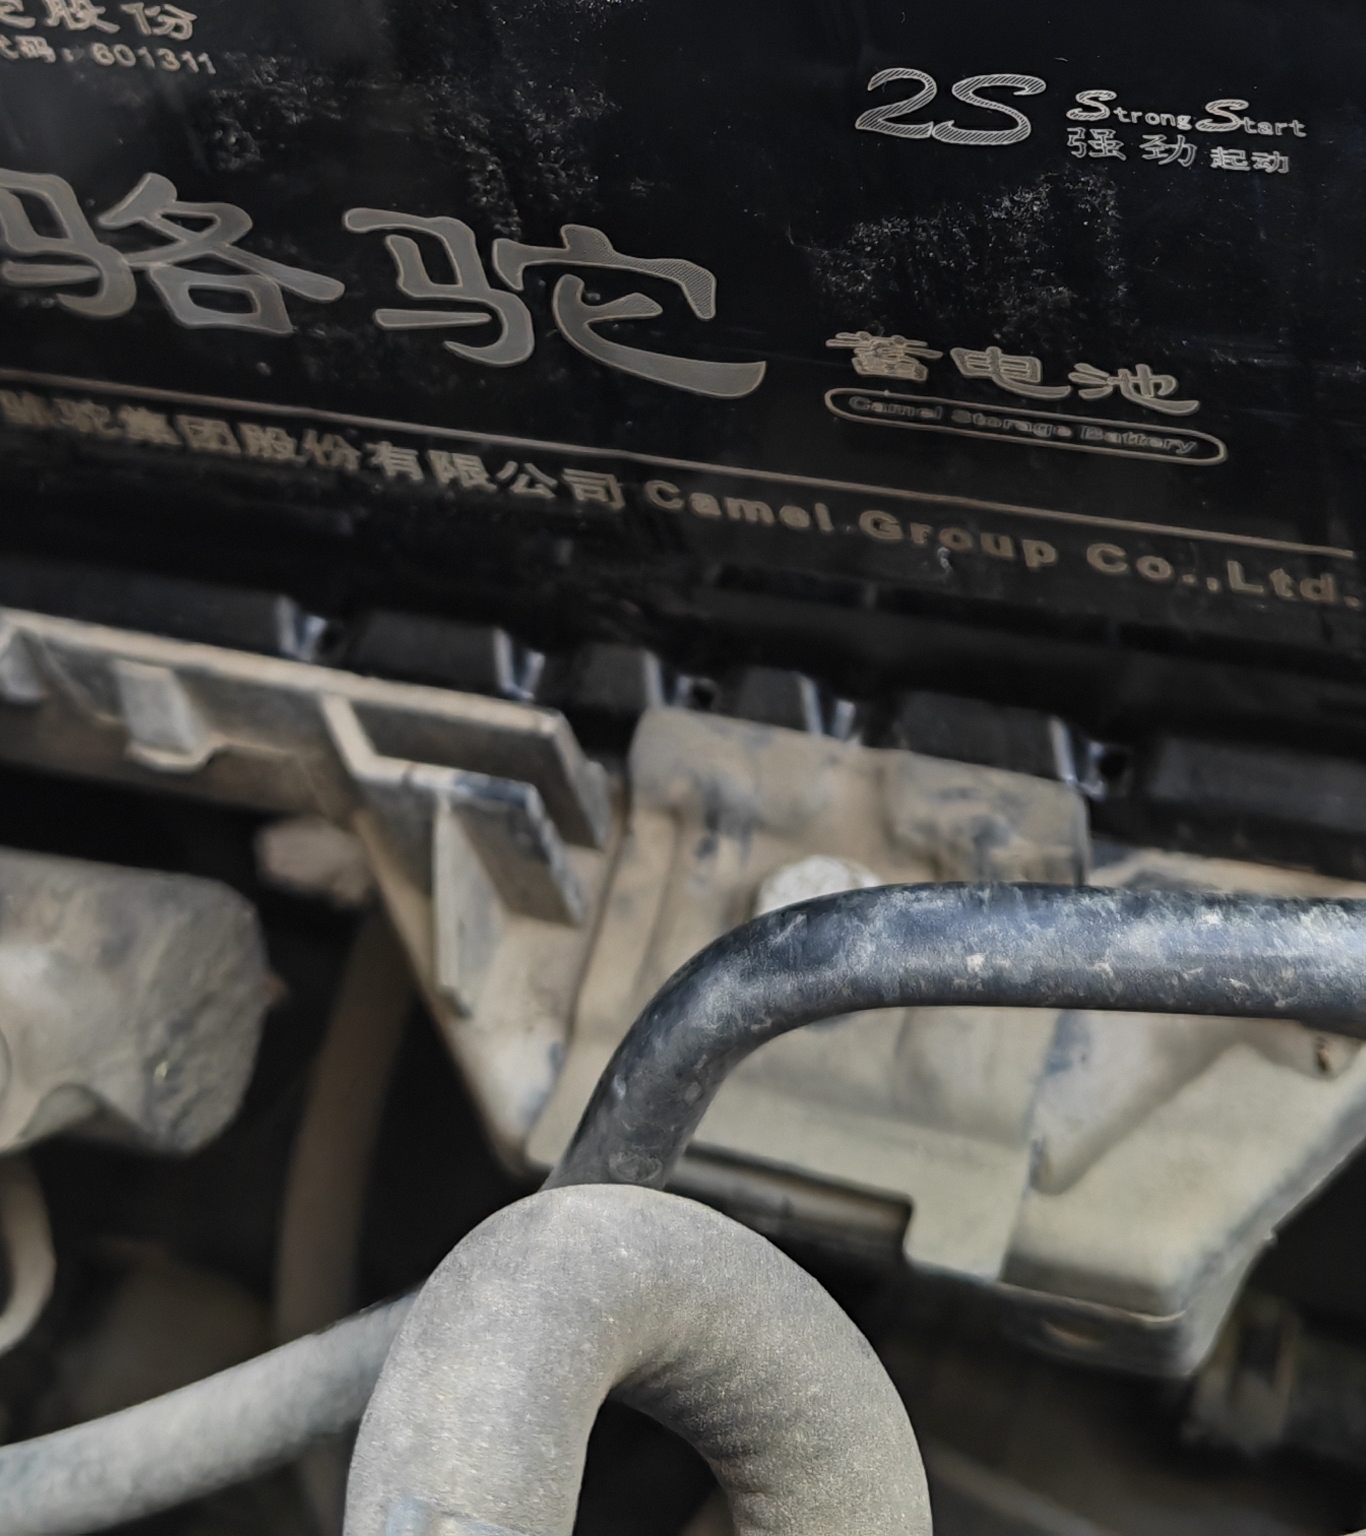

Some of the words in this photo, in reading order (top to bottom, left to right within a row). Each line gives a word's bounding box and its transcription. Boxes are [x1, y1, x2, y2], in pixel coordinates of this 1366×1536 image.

[855, 67, 1047, 146] 2S
[825, 331, 1201, 417] 蓄电池
[643, 478, 834, 532] Camel
[858, 508, 1058, 571] Group
